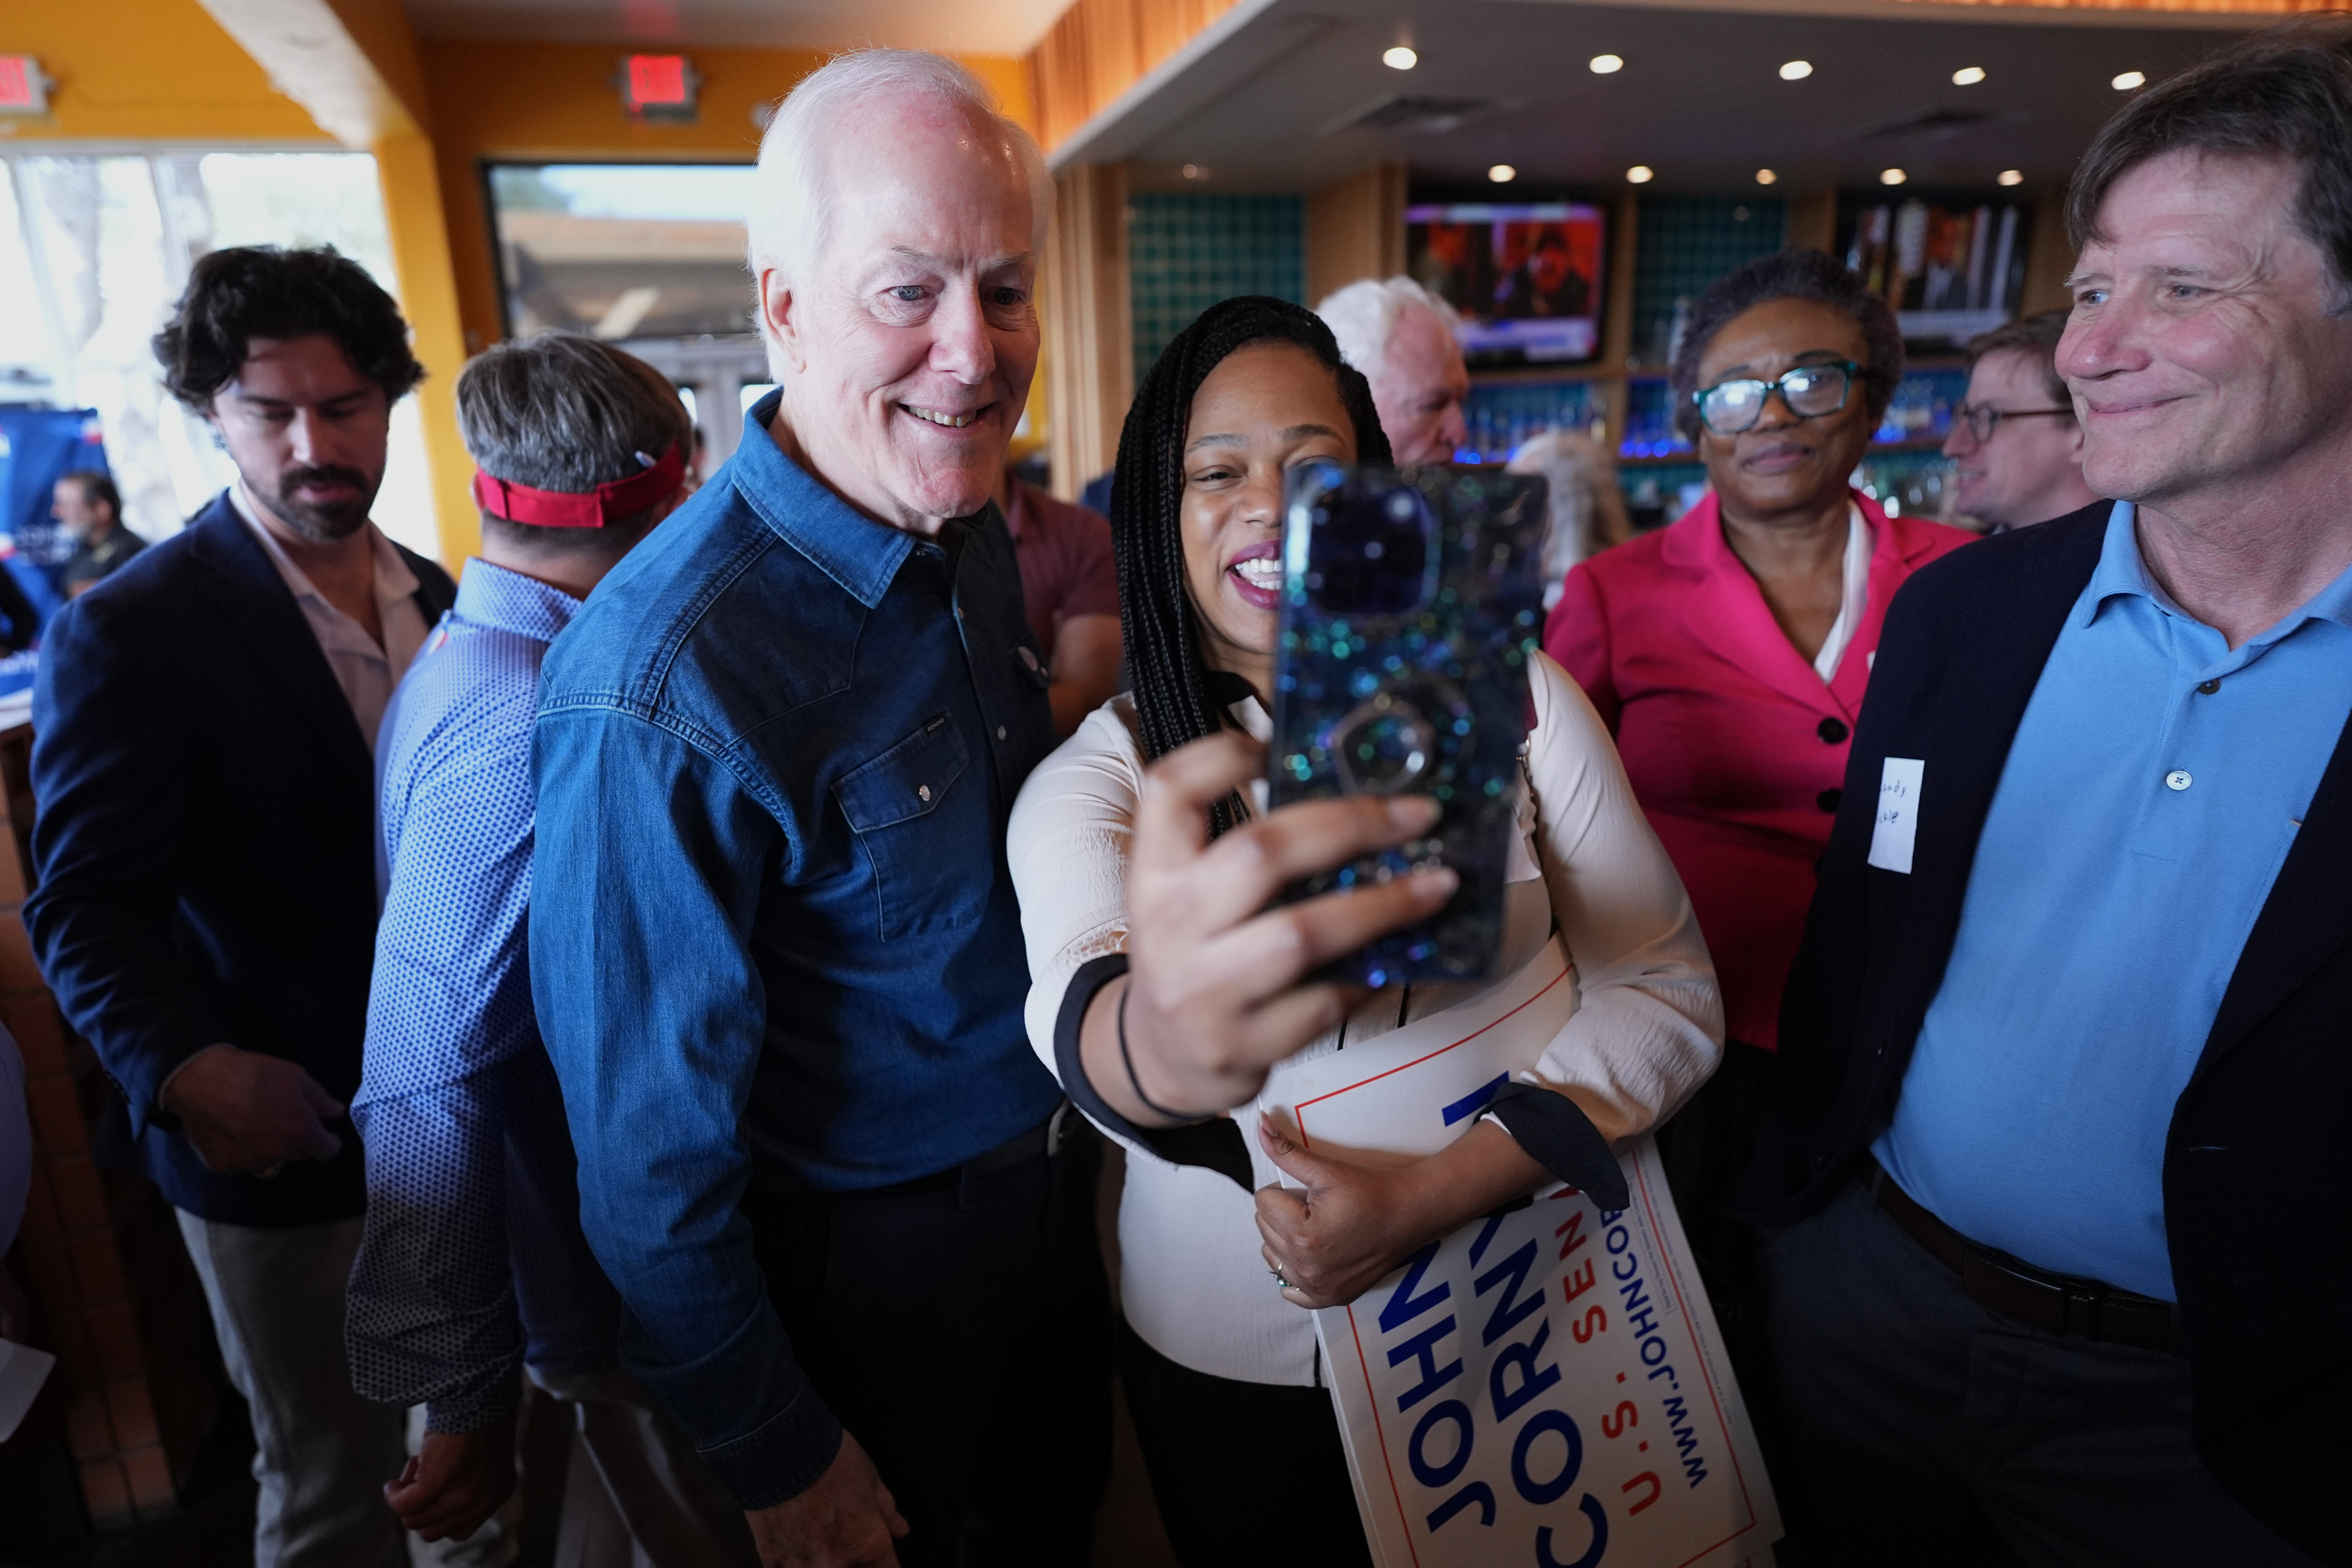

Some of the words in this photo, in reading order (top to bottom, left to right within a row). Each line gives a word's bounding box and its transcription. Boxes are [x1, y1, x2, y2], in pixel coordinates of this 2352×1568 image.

[1548, 1186, 1607, 1343] SEN
[1379, 1239, 1496, 1534] JOHN
[1601, 1371, 1662, 1517] U.S.
